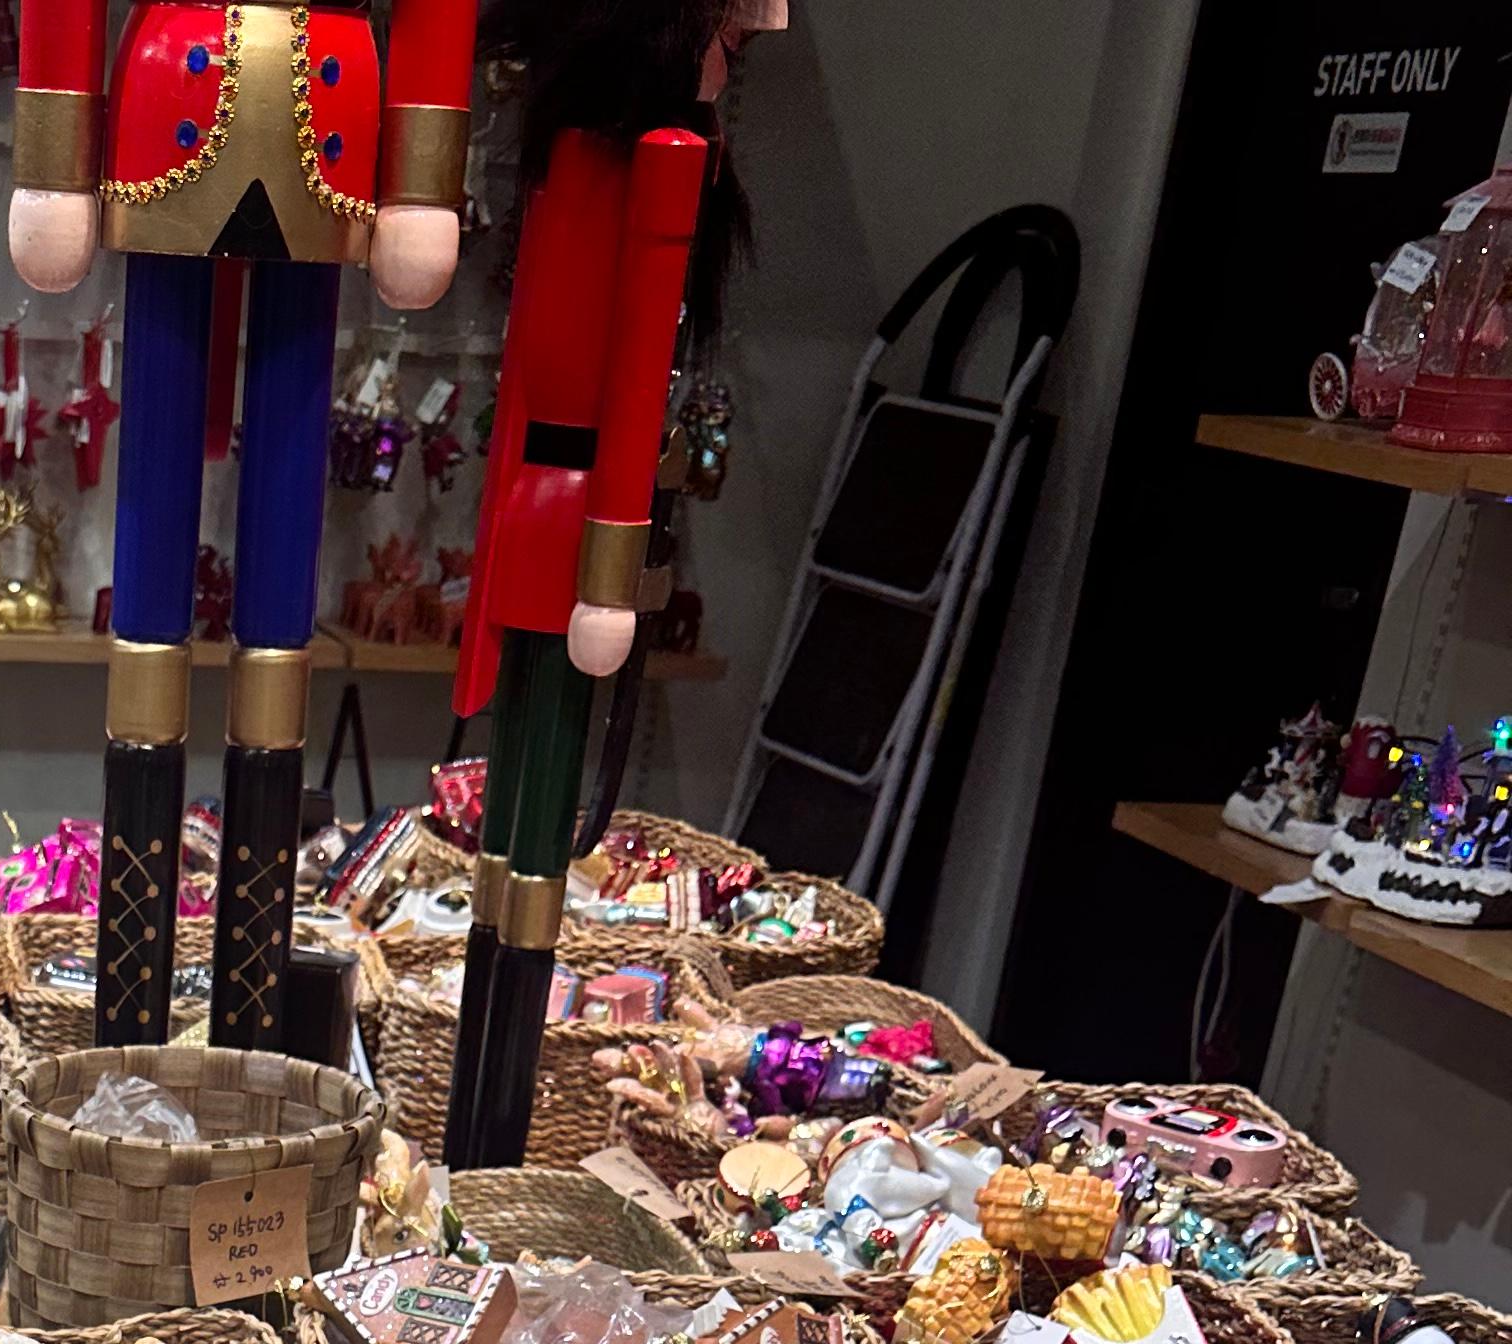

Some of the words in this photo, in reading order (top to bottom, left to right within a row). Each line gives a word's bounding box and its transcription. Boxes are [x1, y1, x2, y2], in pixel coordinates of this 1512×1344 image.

[1314, 52, 1392, 97] STAFF
[1391, 45, 1462, 94] ONLY
[229, 1243, 258, 1260] RED
[361, 1273, 396, 1310] Candy
